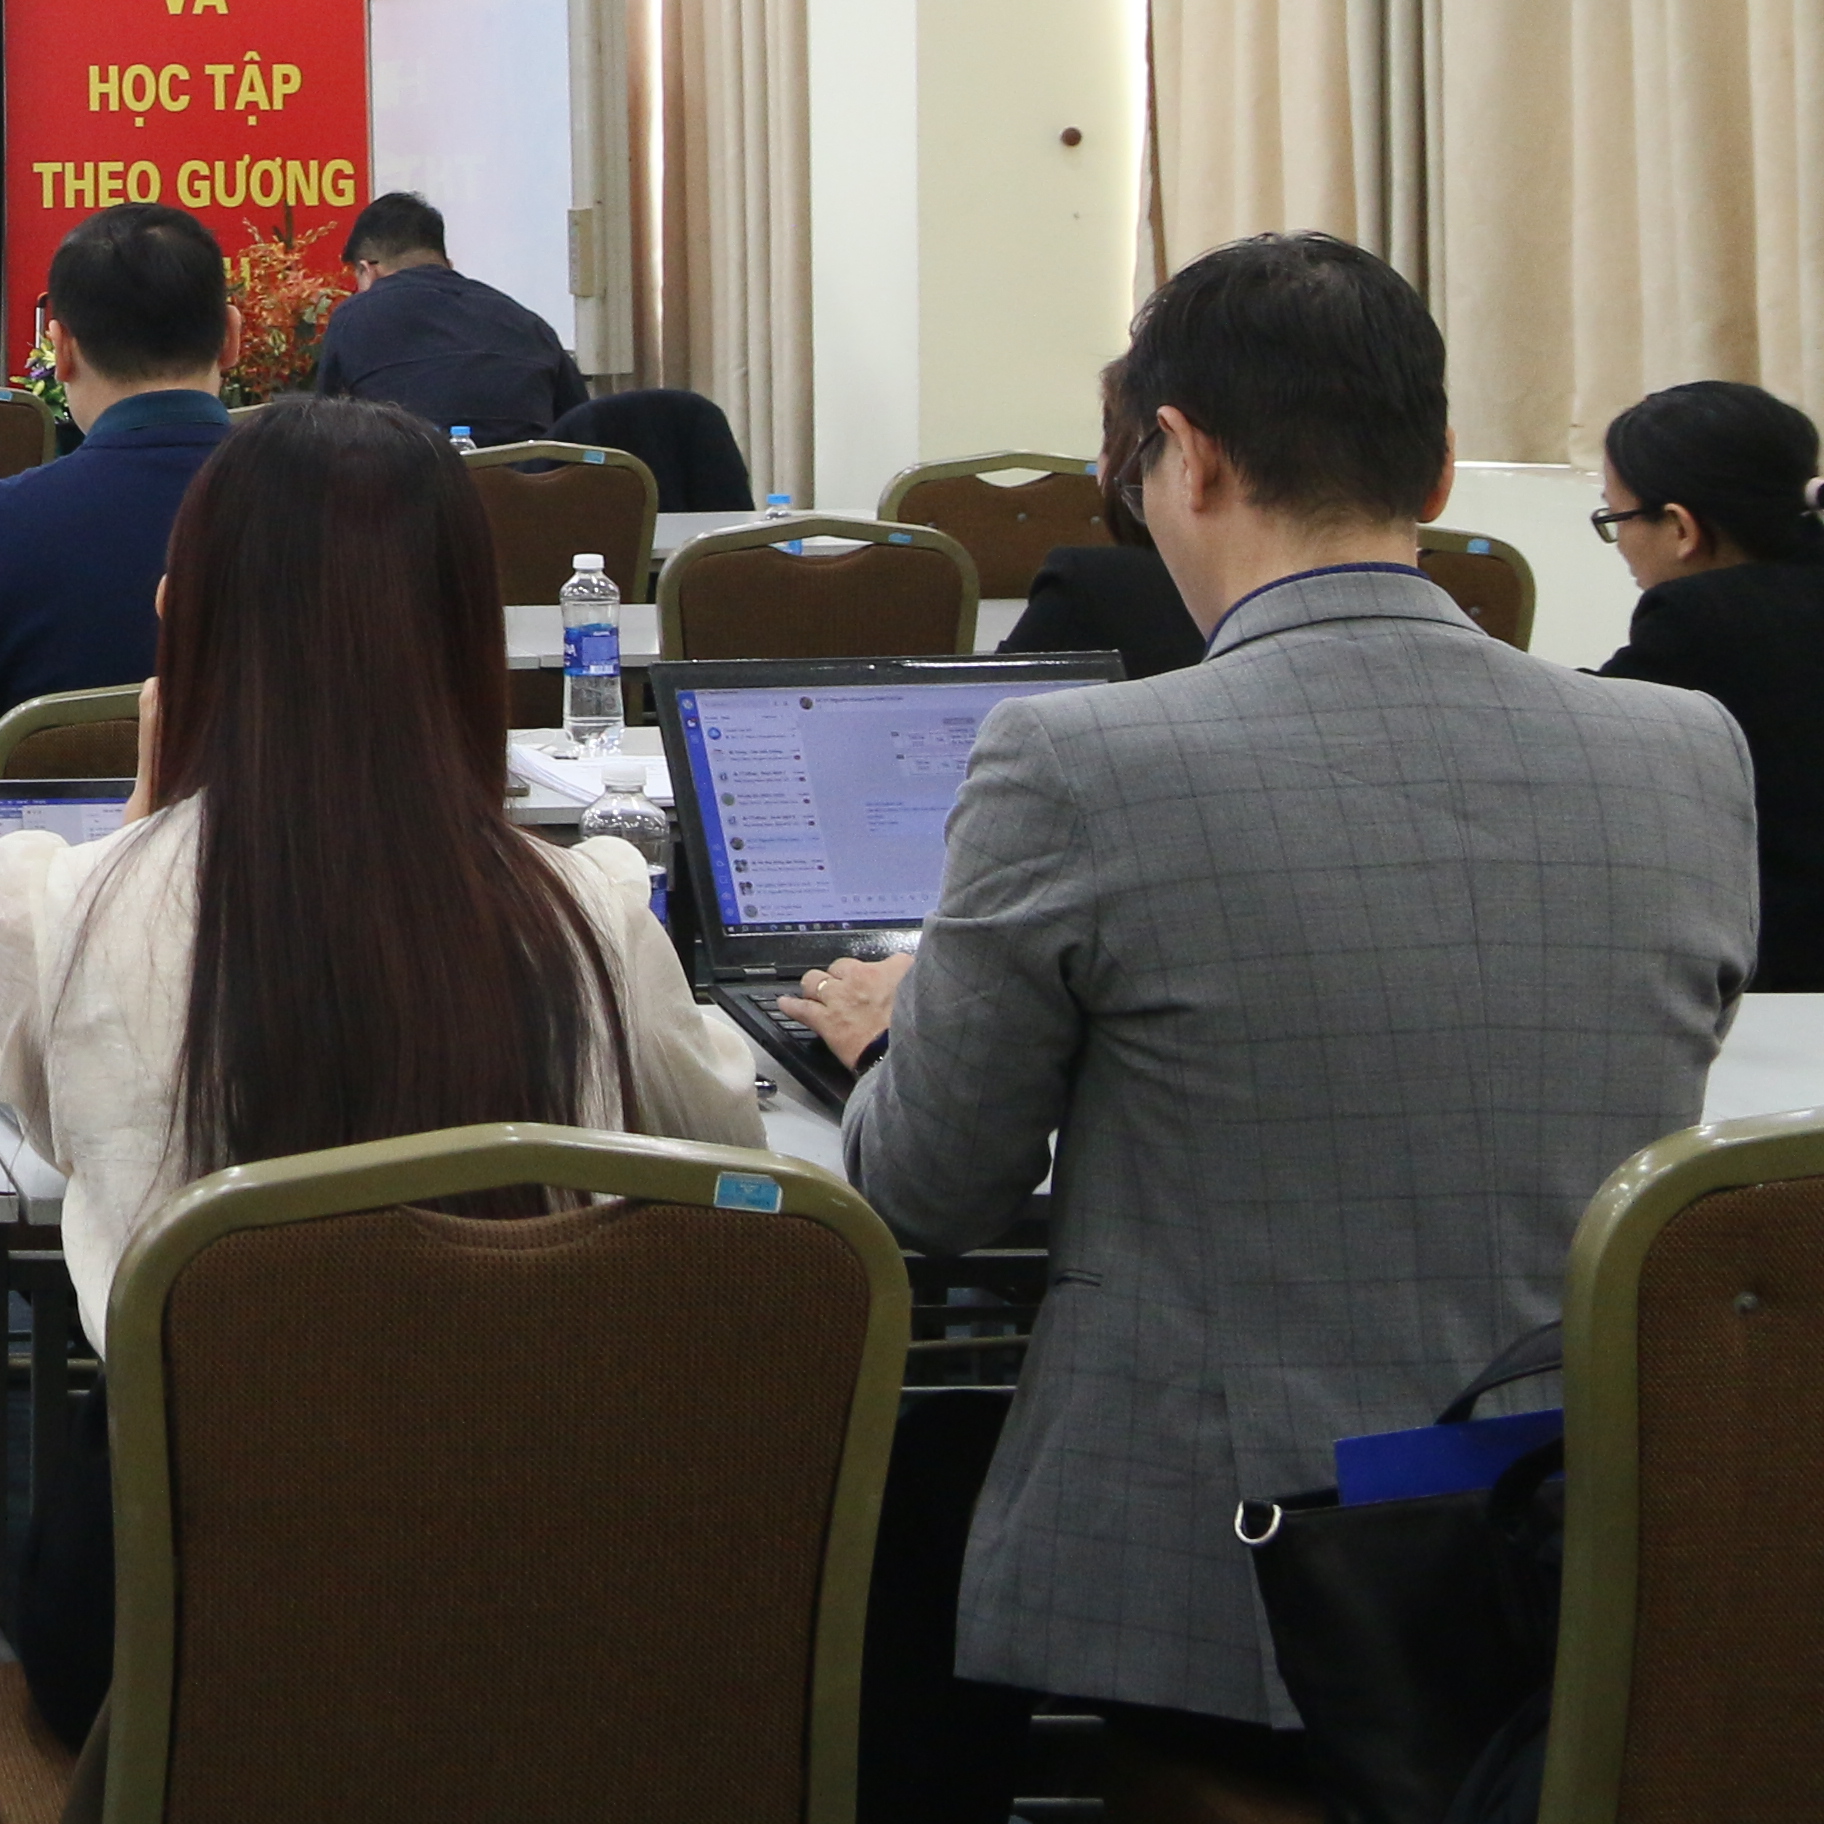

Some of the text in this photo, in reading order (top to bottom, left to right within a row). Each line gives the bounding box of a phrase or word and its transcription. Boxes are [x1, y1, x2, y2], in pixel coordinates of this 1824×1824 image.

[89, 51, 301, 126] HỌC TẬP
[33, 155, 354, 208] THEO GƯƠNG
